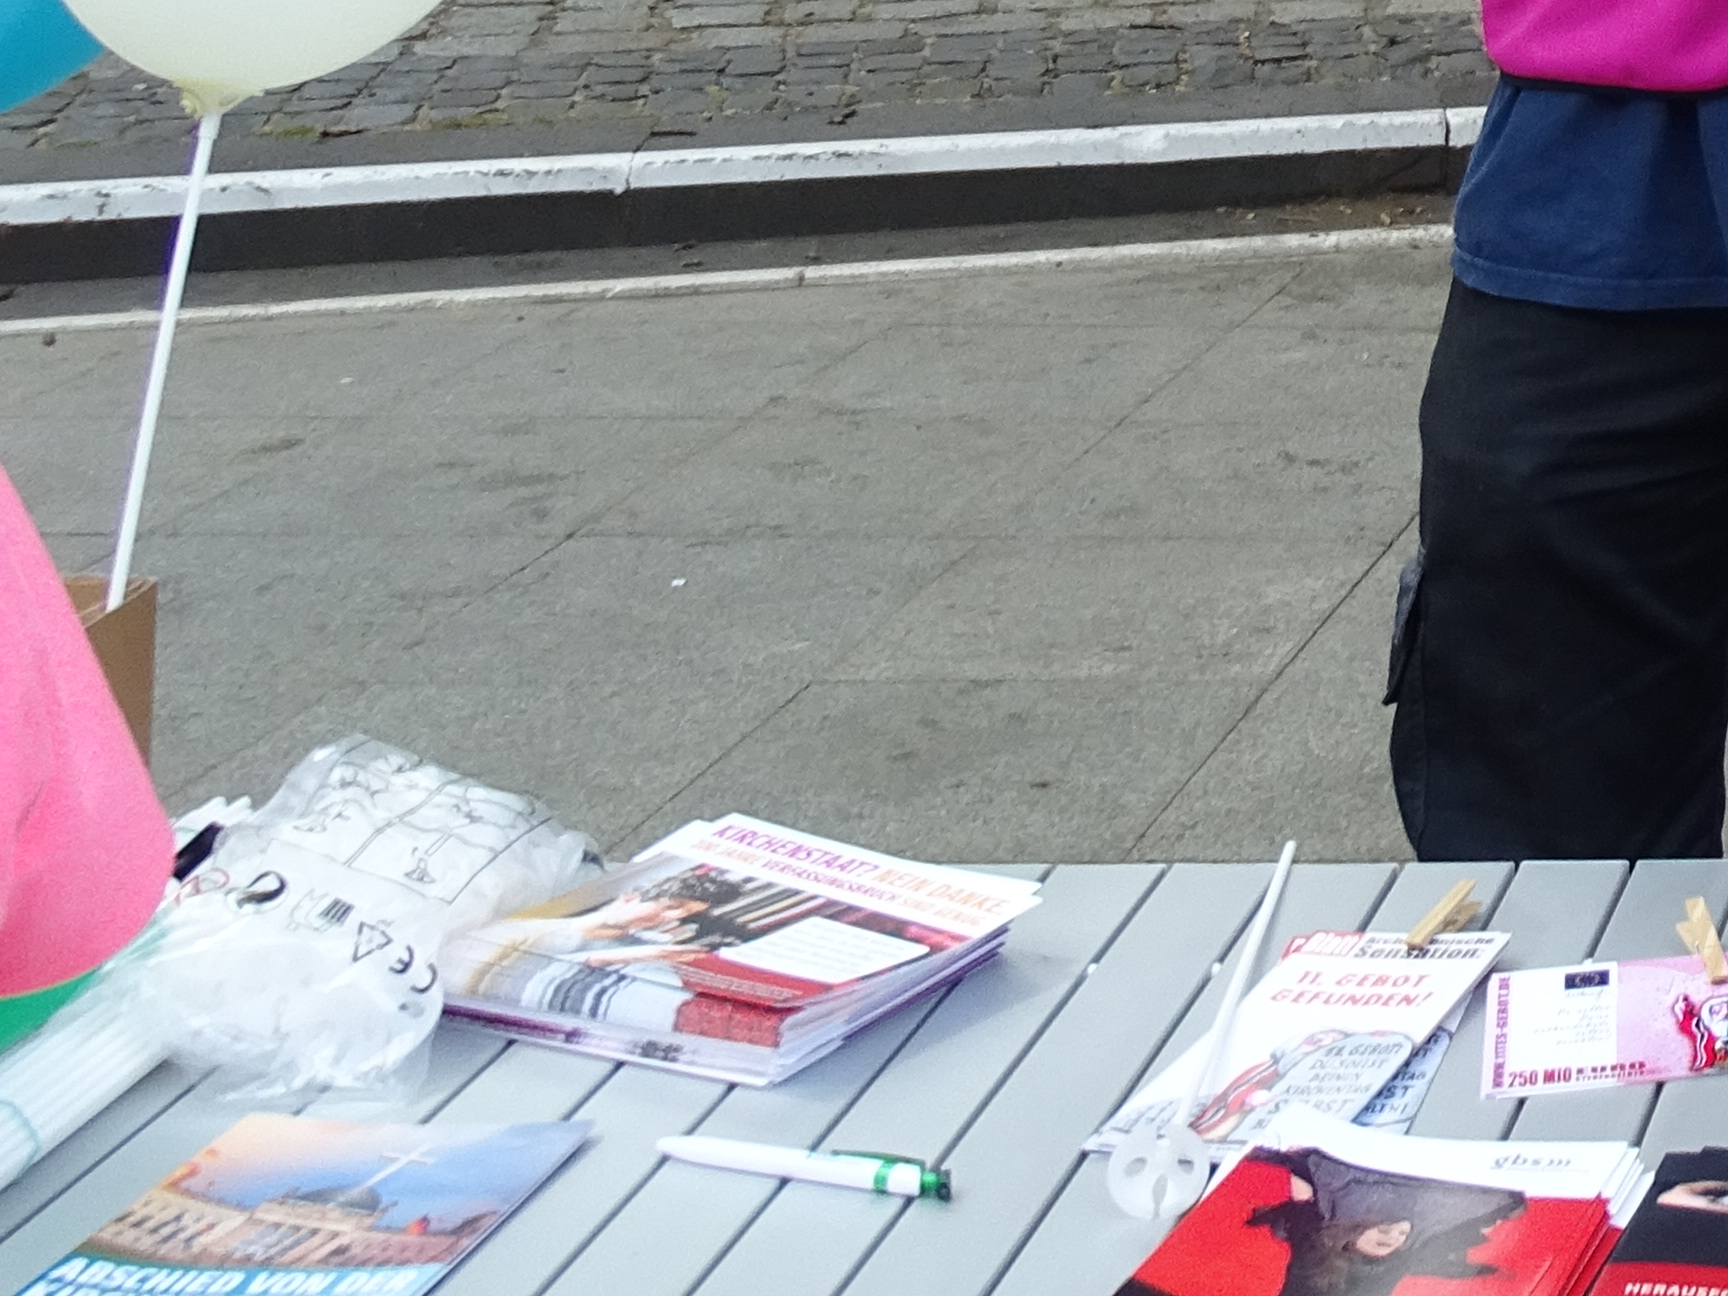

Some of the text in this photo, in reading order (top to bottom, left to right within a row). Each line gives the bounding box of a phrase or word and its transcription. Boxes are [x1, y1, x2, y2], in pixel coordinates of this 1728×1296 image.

[713, 824, 880, 878] KIRCHENSTAAT?
[1334, 972, 1432, 989] GEBOT
[1270, 988, 1435, 1007] GEFUNDEN!
[1508, 1069, 1538, 1089] 250
[1543, 1066, 1572, 1085] MIO
[48, 1257, 247, 1294] ABSCHIED
[246, 1270, 337, 1295] VON
[330, 1269, 420, 1295] DER
